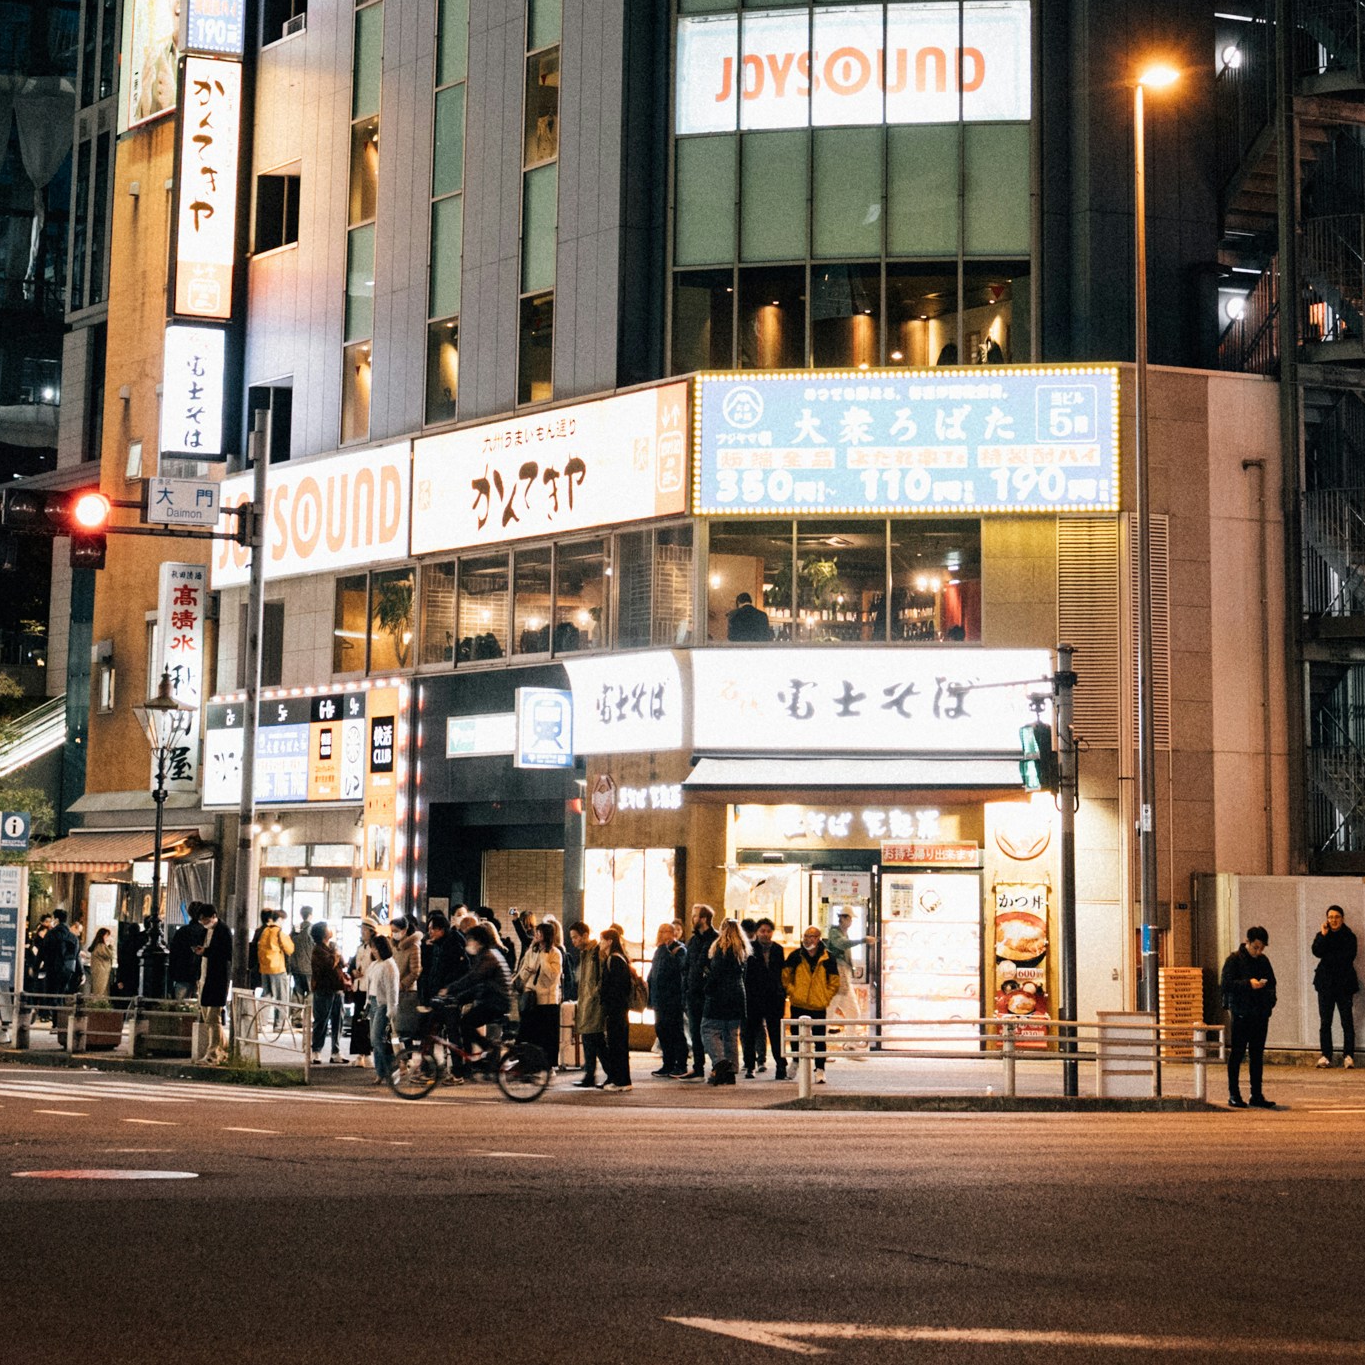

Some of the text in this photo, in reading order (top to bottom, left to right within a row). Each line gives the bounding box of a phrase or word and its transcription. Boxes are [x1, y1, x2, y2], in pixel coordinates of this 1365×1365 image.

[715, 47, 985, 102] JOYSOUND
[156, 487, 214, 508] 大門
[471, 451, 587, 531] かんてきや
[166, 507, 203, 520] Daimon
[373, 725, 393, 747] 快活
[373, 748, 392, 764] CLUB
[883, 846, 979, 863] お持ち帰り出来ます
[998, 893, 1044, 910] かつ丼
